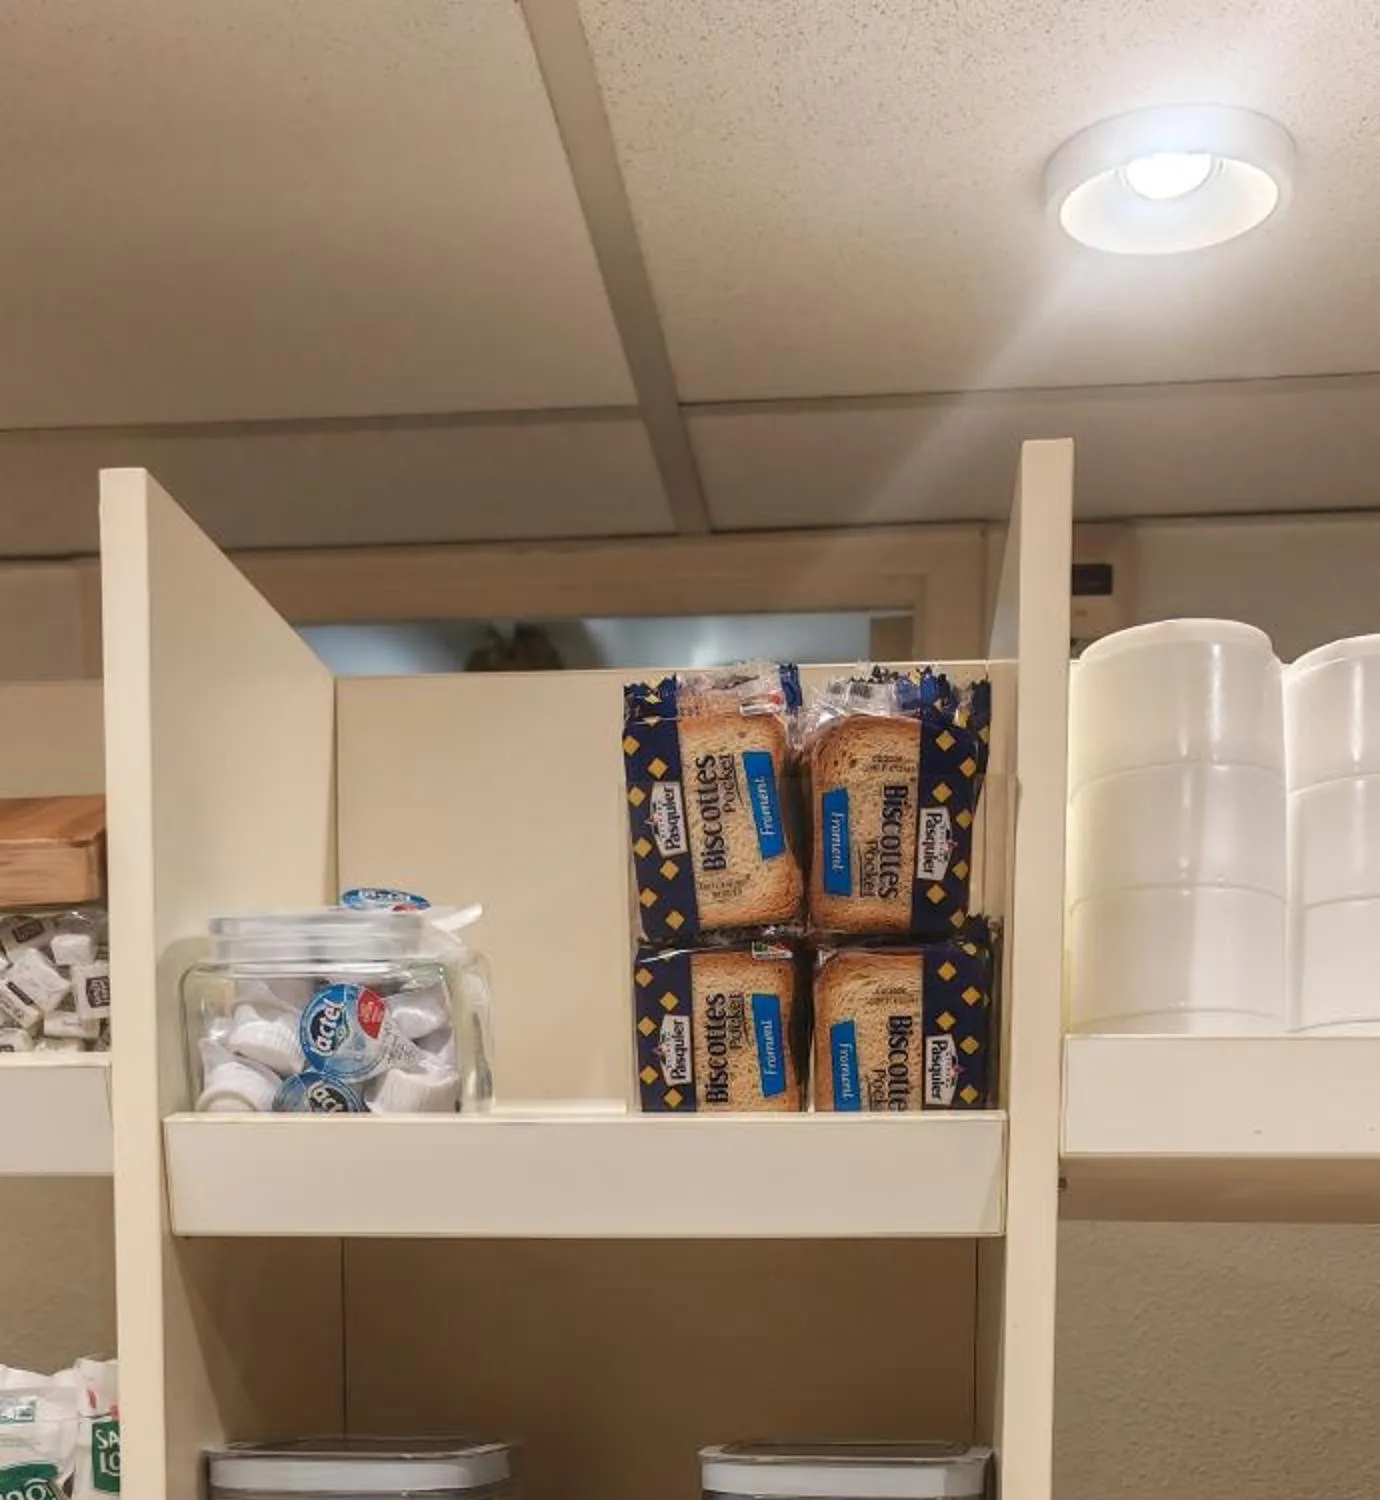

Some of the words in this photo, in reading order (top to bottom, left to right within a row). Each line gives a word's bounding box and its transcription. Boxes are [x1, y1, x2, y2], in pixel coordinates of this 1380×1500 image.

[663, 785, 684, 851] Pasquier
[696, 753, 727, 873] Biscottes
[758, 776, 776, 837] Froment
[832, 811, 844, 876] Froment
[878, 785, 909, 900] Biscottes
[918, 812, 943, 877] Pasquier
[669, 1017, 692, 1083] Pasquier
[703, 992, 728, 1104] Biscottes
[837, 1042, 852, 1101] Froment
[887, 1014, 914, 1112] Biscotte
[925, 1037, 950, 1102] Pasquier
